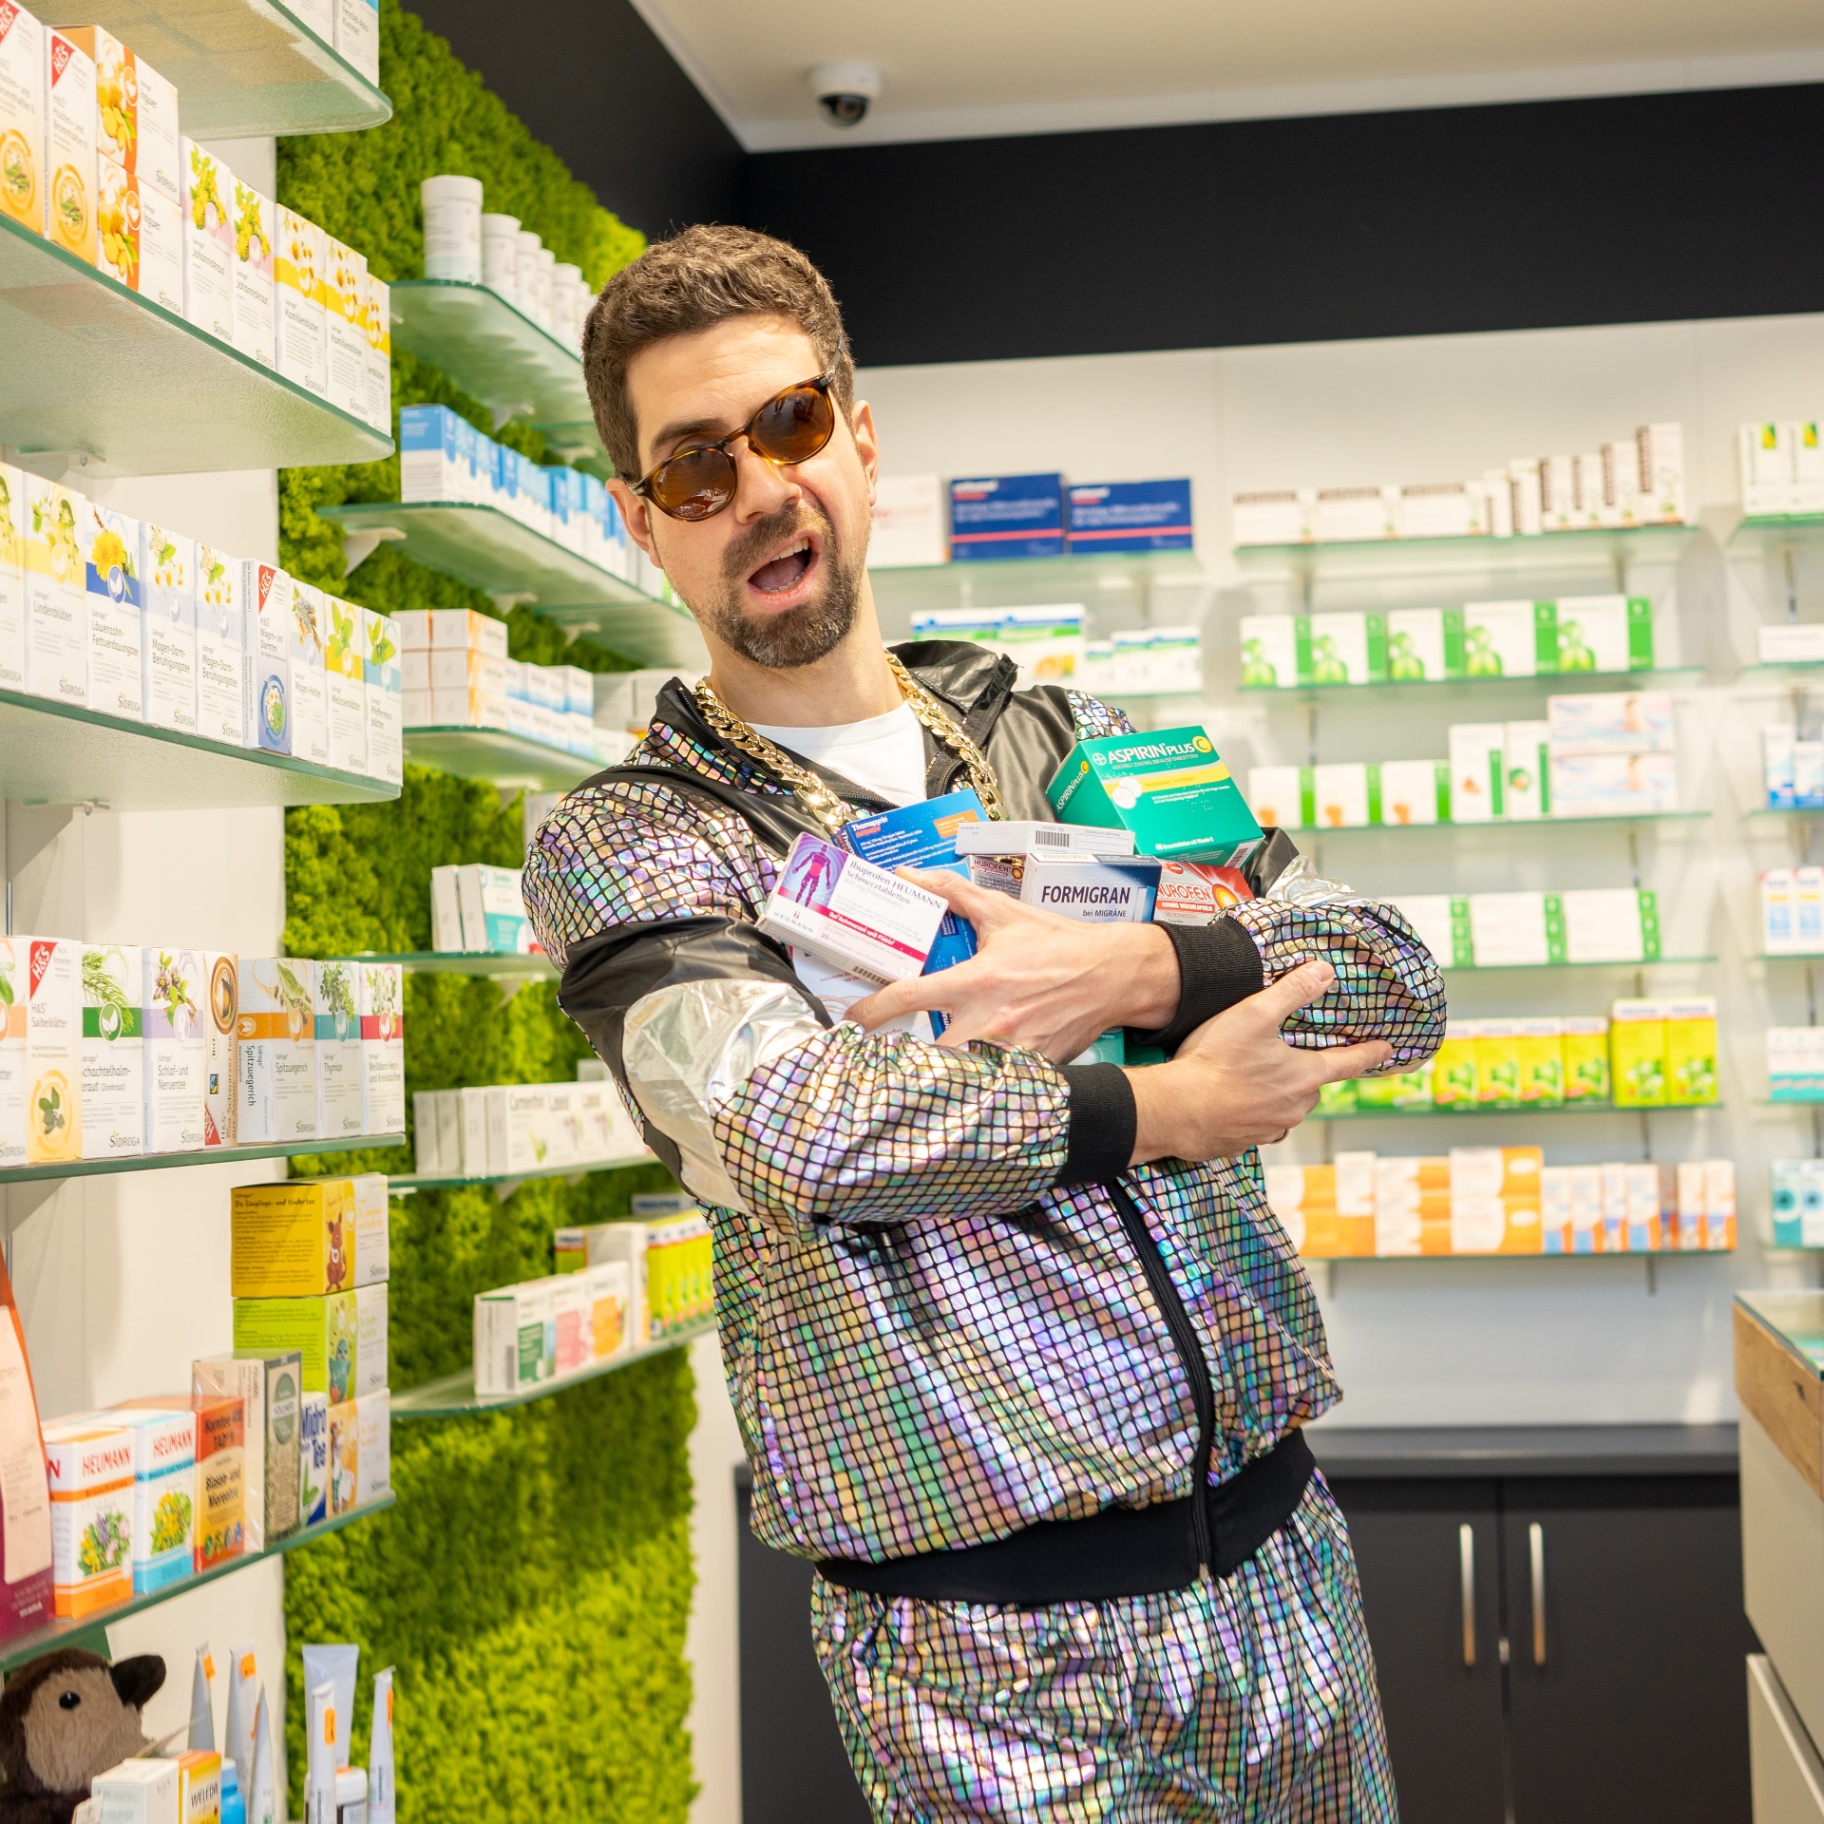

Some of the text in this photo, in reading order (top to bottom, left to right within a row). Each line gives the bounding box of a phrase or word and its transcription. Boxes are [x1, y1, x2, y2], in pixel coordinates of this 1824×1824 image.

[59, 679, 85, 698] SIDROGA
[1107, 744, 1164, 765] ASPIRIN
[1166, 742, 1195, 757] PLUS
[1055, 783, 1075, 813] ASPIRIN
[851, 815, 888, 832] Thomapyrin
[974, 859, 1009, 873] NUROFEN
[847, 869, 911, 905] Schmerztabletten
[849, 860, 941, 909] Ibuprofen HEUMANN
[1041, 885, 1131, 904] FORMIGRAN
[774, 911, 814, 933] HEUMANN
[1082, 909, 1127, 918] bei MIGRÄNE
[32, 945, 50, 980] H&S
[245, 1045, 256, 1107] Spitzwegerich
[276, 1062, 308, 1075] Spitzwegerich
[324, 1062, 343, 1075] Thymian
[109, 1133, 140, 1148] SIDROGA
[153, 1430, 193, 1459] HEUMANN
[82, 1446, 131, 1477] HEUMANN
[191, 1781, 219, 1808] WELEDA
